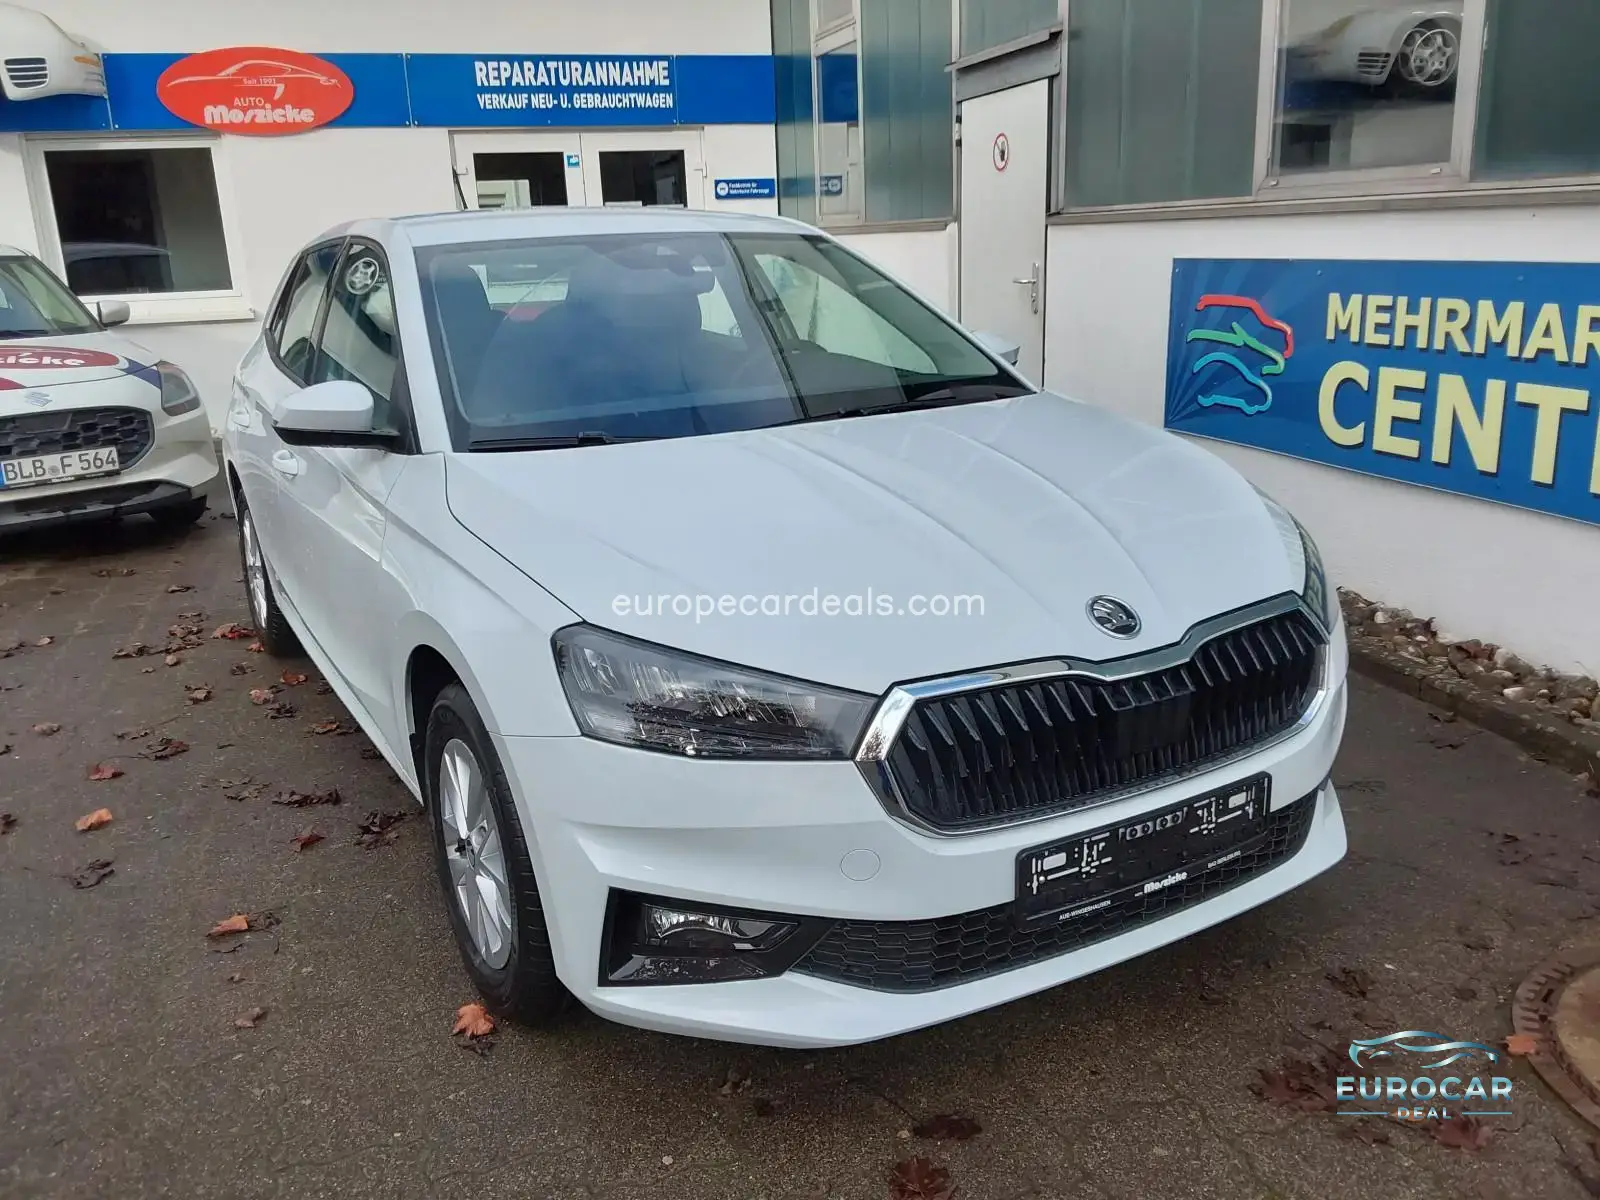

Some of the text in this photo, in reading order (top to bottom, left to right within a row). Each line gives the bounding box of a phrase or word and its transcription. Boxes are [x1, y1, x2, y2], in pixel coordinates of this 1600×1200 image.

[474, 60, 670, 87] REPARATURANNAHME
[233, 97, 265, 107] AUTO
[477, 93, 673, 110] VERKAUF NEU- U. GEBRAUCHTWAGEN
[1325, 292, 1600, 365] MEHRMAR
[1317, 360, 1600, 498] CENT
[3, 449, 118, 482] BLB F 564
